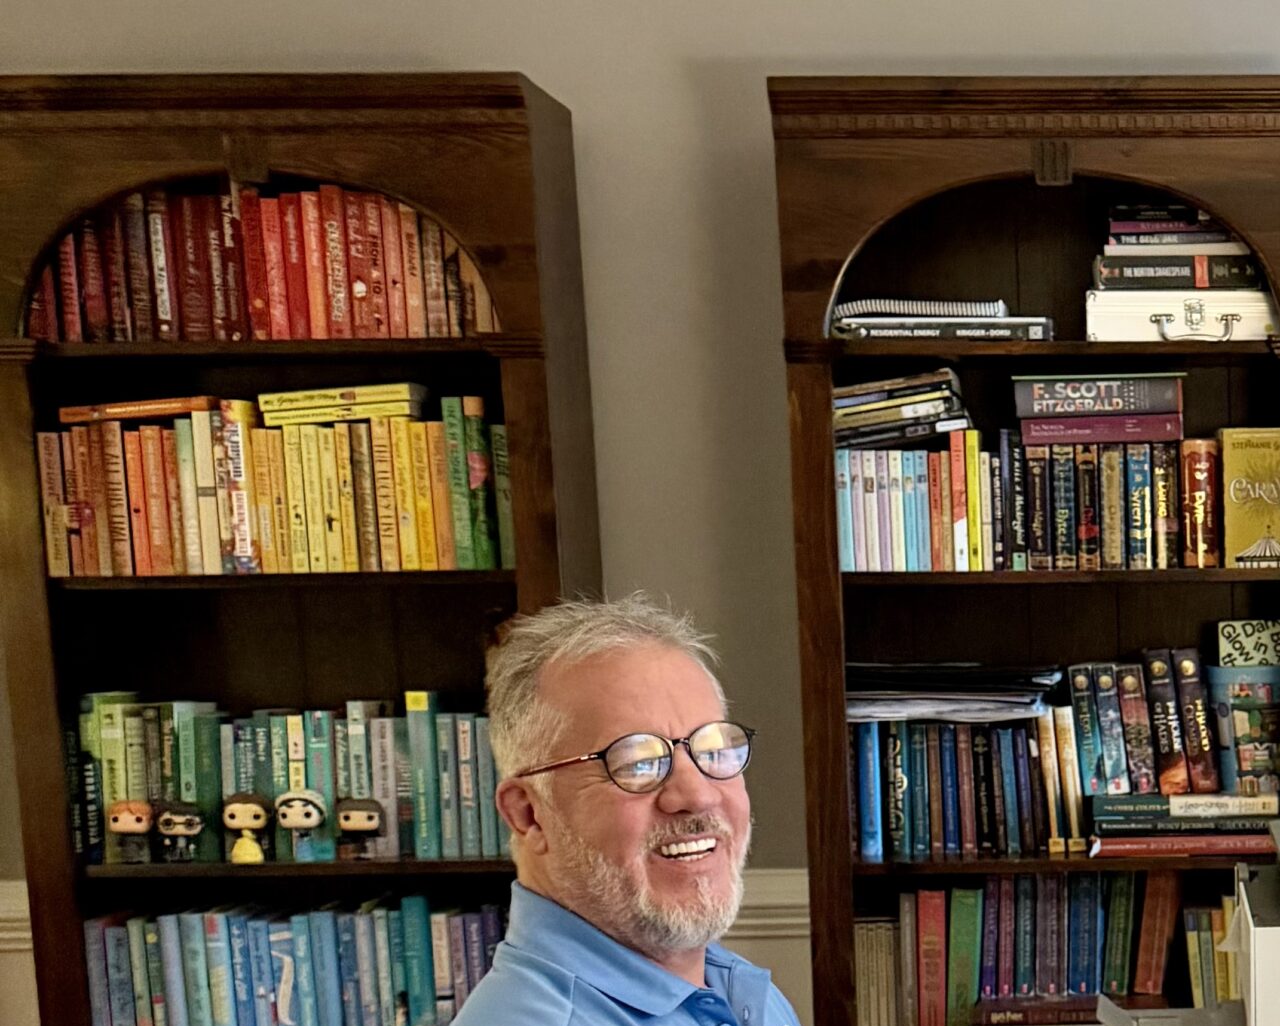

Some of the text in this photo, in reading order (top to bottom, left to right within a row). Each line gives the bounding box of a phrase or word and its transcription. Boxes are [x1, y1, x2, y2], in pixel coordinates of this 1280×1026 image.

[370, 235, 379, 266] FROM
[1121, 235, 1137, 244] THE
[1139, 235, 1158, 244] BELL
[1160, 234, 1178, 243] JAR
[1156, 266, 1190, 277] SHAKESPEARE
[1033, 381, 1122, 399] F. SCOTT
[1033, 398, 1124, 413] FITZGERALD
[493, 433, 509, 477] COLLIDE
[1231, 441, 1272, 450] STEPHANIE
[374, 444, 395, 538] THE LUCKY LIST
[1130, 486, 1146, 526] Syren
[1012, 494, 1026, 545] Mockingbird
[1054, 509, 1069, 534] Flyte
[1220, 624, 1254, 662] Glow
[1252, 636, 1268, 655] in
[1153, 714, 1170, 754] HADES
[1167, 714, 1183, 753] HOUSE
[1196, 711, 1210, 752] BLOOD
[84, 764, 100, 844] YERBA BUENA
